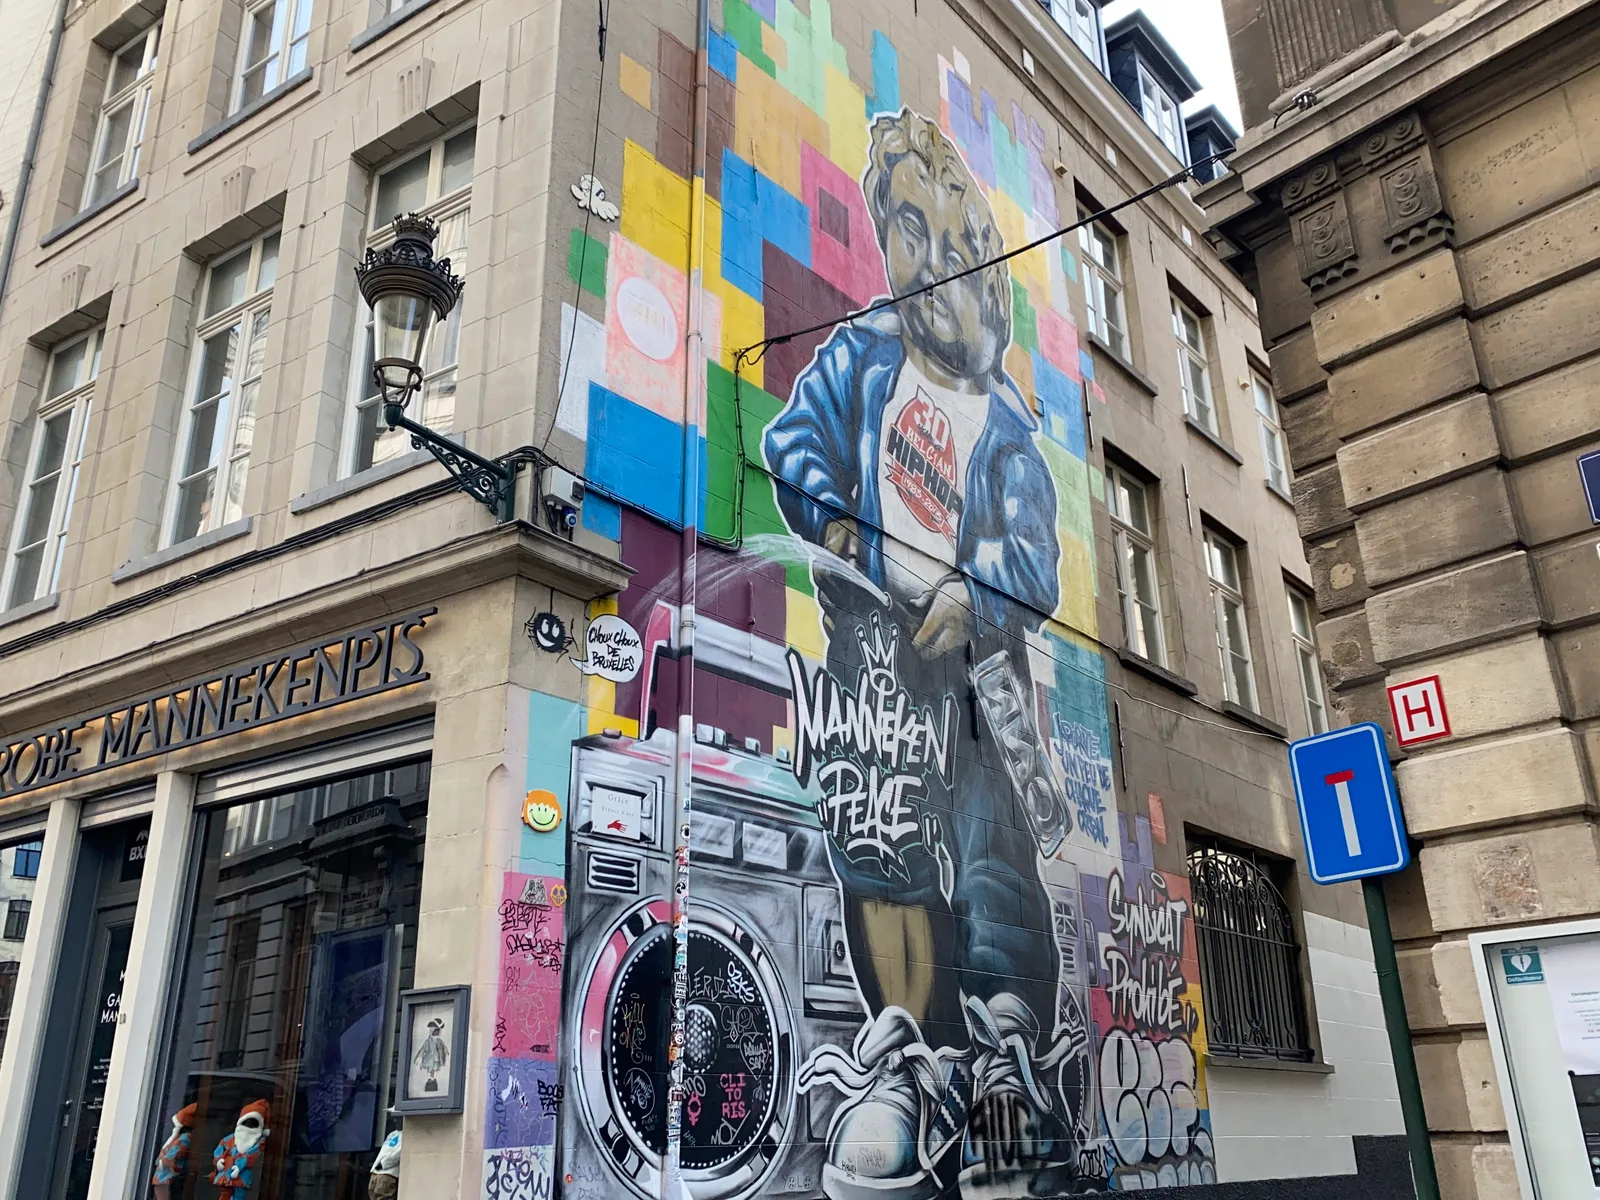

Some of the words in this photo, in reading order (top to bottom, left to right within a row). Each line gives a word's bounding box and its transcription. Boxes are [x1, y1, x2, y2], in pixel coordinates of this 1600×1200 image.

[913, 396, 950, 452] 30
[606, 644, 621, 657] DE
[592, 651, 635, 672] BRUXELLES
[100, 607, 438, 766] MANNEKENPIS
[789, 652, 952, 777] MANNEKEN
[1402, 690, 1435, 732] H
[607, 793, 629, 805] Grâce
[819, 760, 923, 862] PEACE
[720, 1072, 746, 1089] CLI
[725, 1088, 742, 1101] TO
[722, 1101, 746, 1119] RIS
